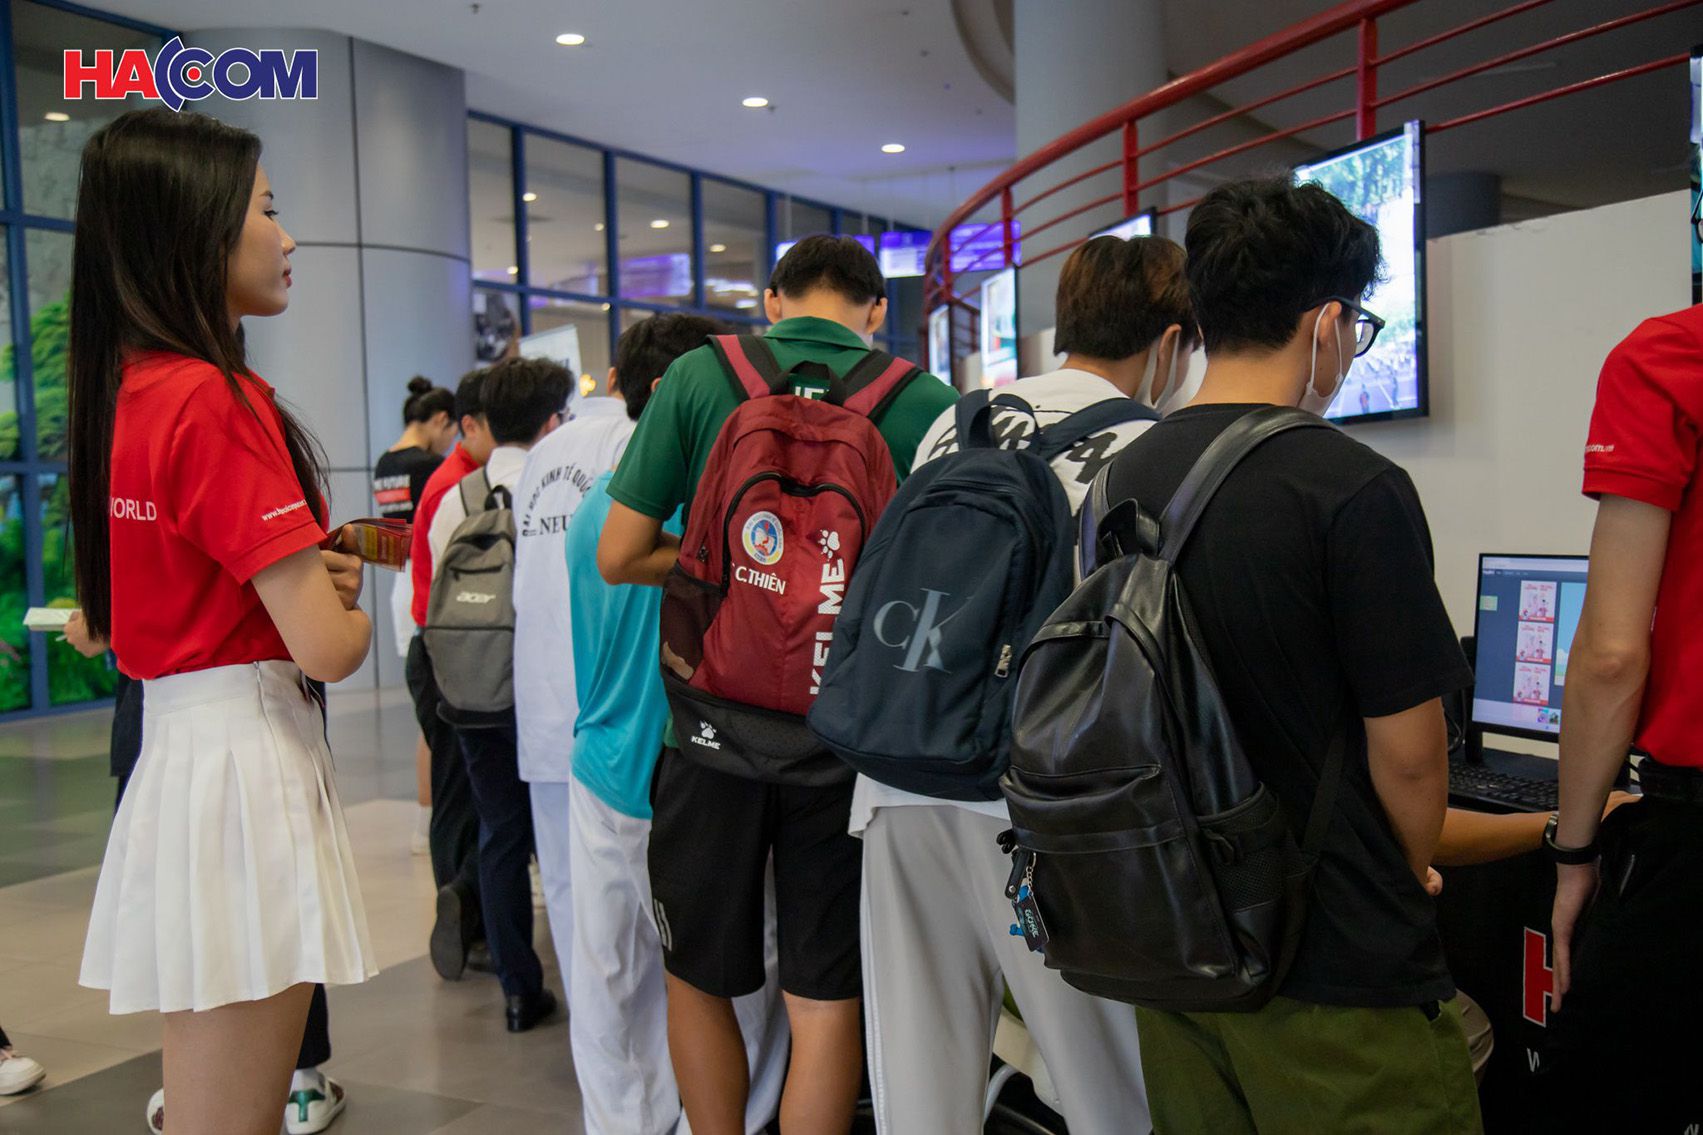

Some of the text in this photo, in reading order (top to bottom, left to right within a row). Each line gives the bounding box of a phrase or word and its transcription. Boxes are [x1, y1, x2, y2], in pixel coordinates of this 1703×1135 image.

[109, 497, 157, 521] ORLD
[455, 590, 497, 604] acer
[691, 735, 721, 750] KELME
